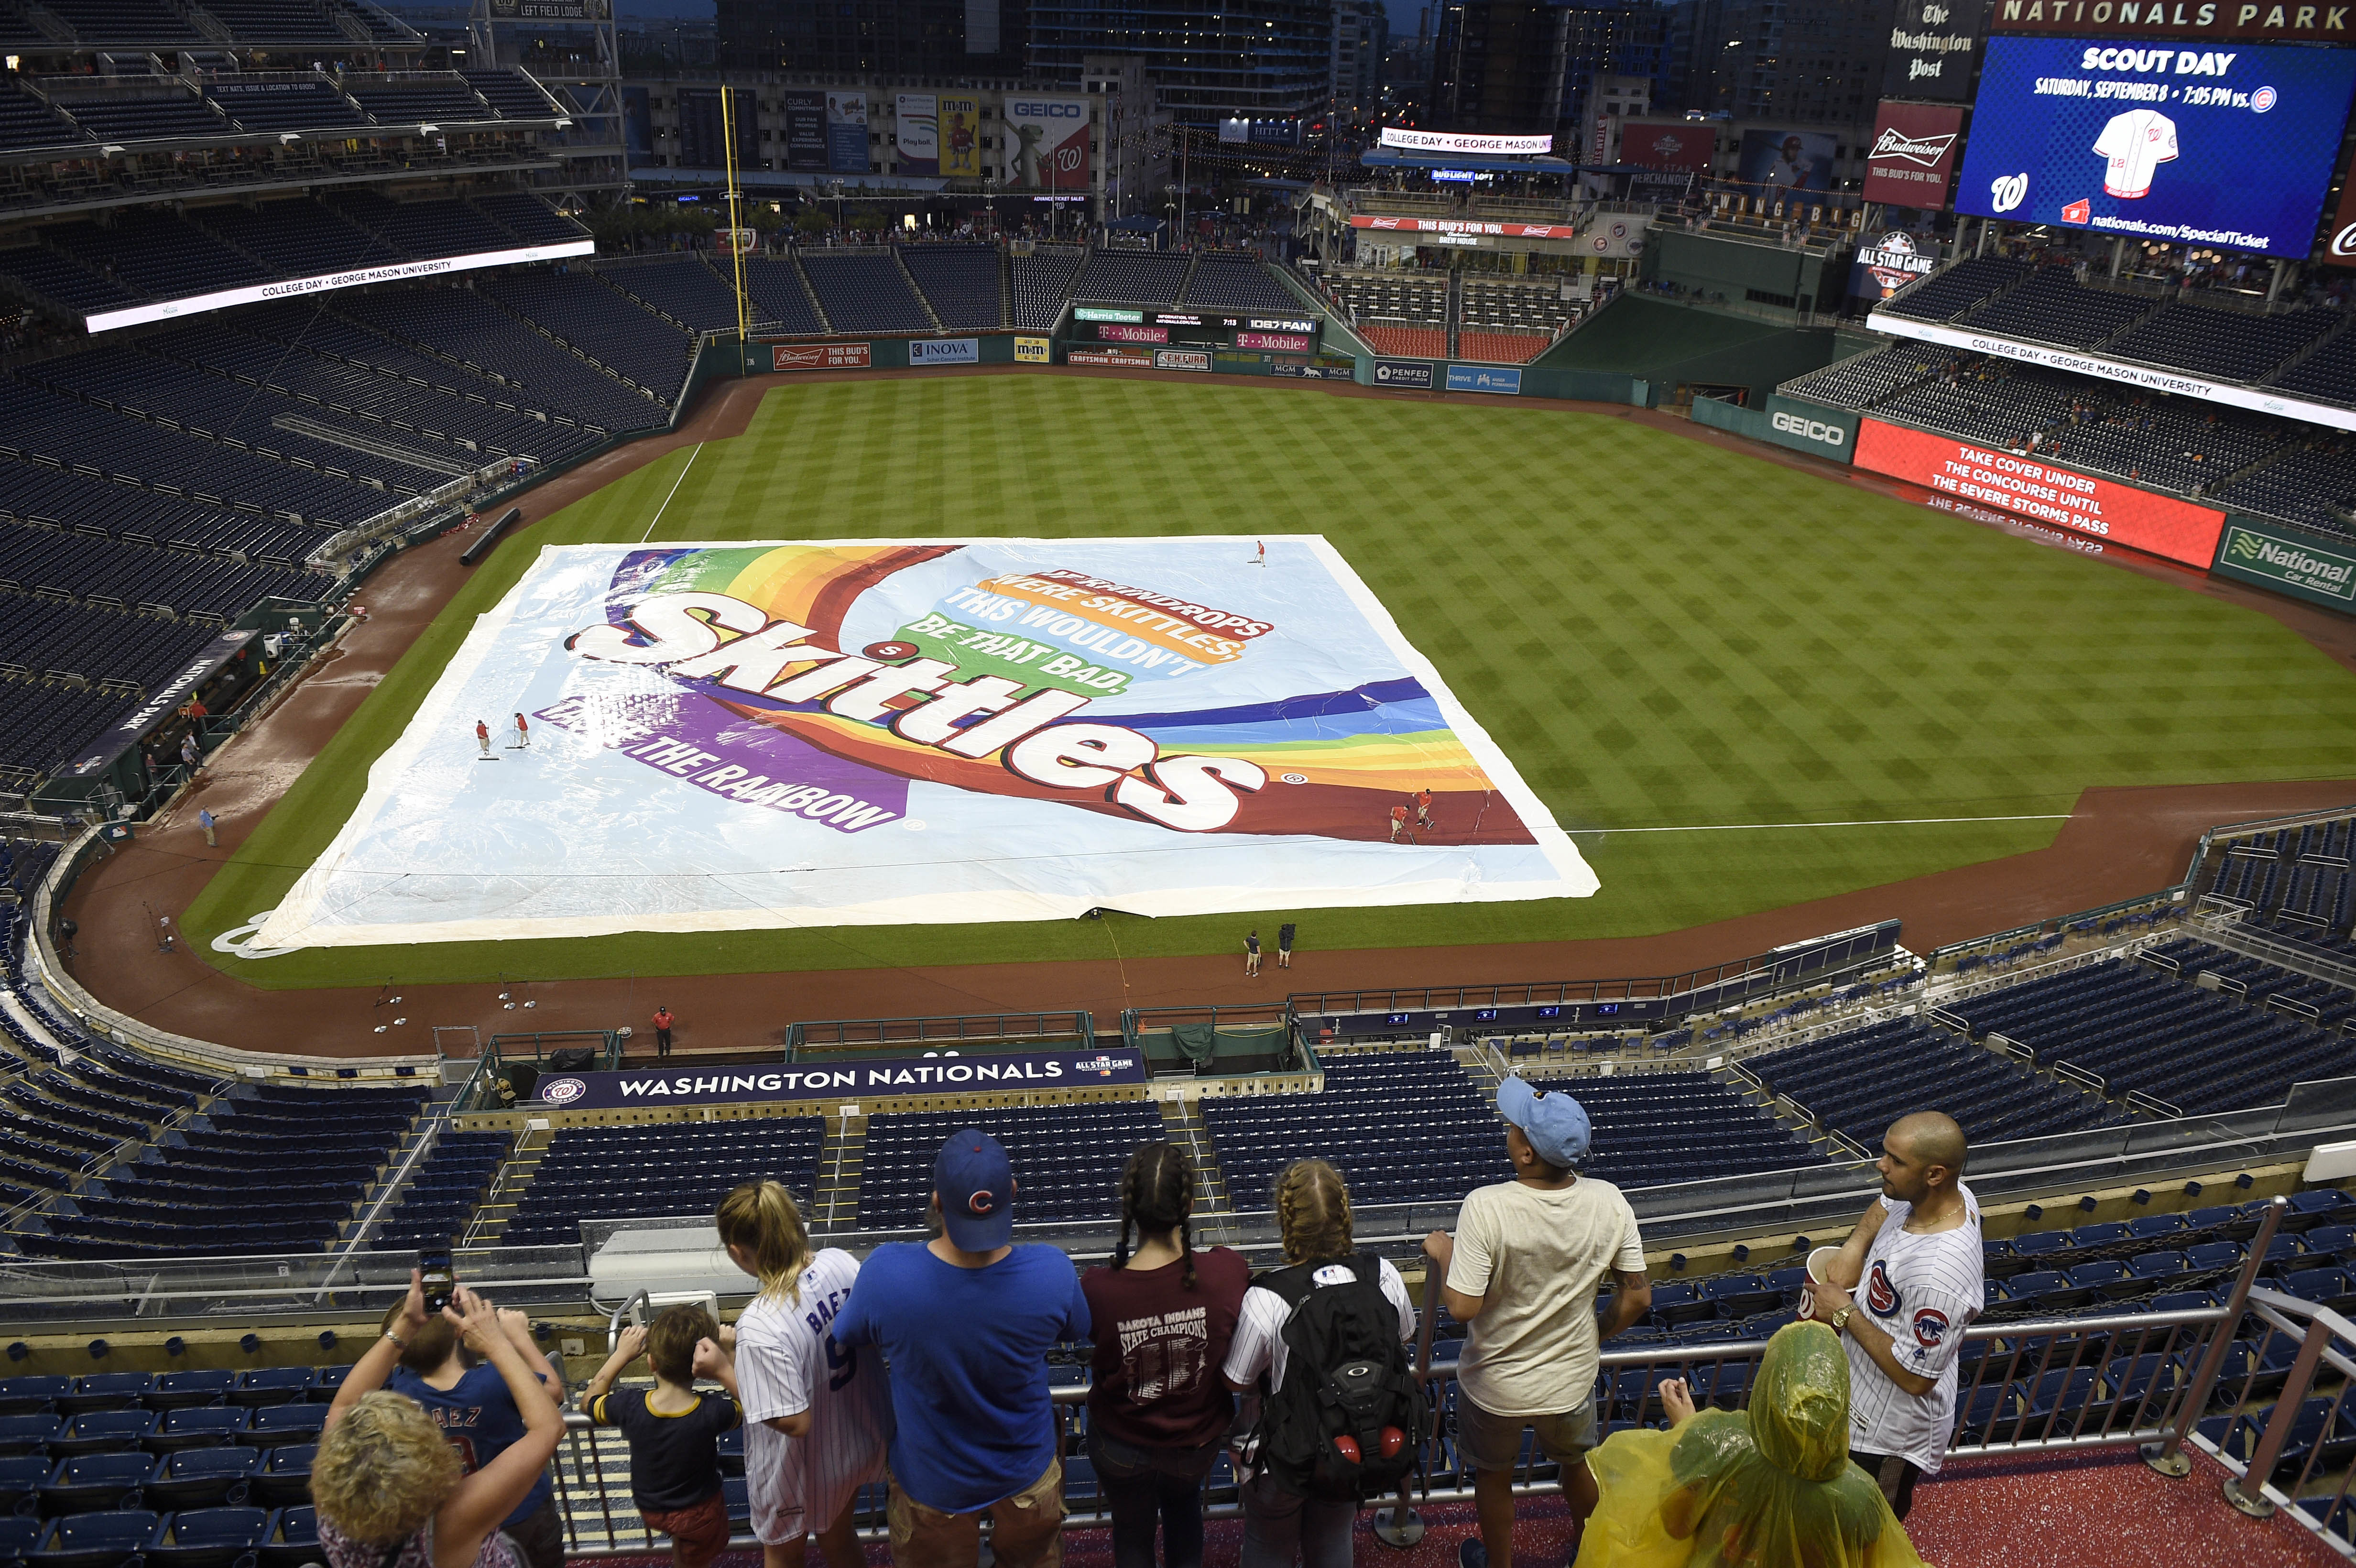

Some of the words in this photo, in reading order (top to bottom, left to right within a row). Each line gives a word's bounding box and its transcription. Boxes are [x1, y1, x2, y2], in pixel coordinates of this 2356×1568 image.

[521, 5, 538, 16] LEFT
[540, 5, 559, 17] FIELD
[561, 6, 583, 17] LODGE
[1922, 4, 1950, 26] The
[2002, 1, 2217, 26] NATIONALS
[2237, 4, 2349, 30] PARK
[1890, 27, 1973, 55] Washington
[1909, 58, 1943, 81] Post
[2081, 47, 2174, 73] SCOUT
[2175, 52, 2237, 76] DAY
[2034, 77, 2092, 100] SATURDAY,
[2094, 81, 2160, 101] SEPTEMBER
[2158, 85, 2169, 102] 8
[2182, 86, 2212, 105] 7:05
[2211, 87, 2233, 106] PM
[2233, 93, 2250, 108] vs.
[1014, 102, 1080, 118] GEICO
[1254, 127, 1281, 135] HITT
[1386, 132, 1418, 144] COLLEGE
[1421, 136, 1442, 146] DAY
[1454, 139, 1502, 149] GEORGE
[1505, 141, 1537, 149] MASON
[1596, 130, 1605, 149] TEAM
[1878, 135, 1944, 155] Budweiser
[2111, 157, 2126, 168] 18
[1450, 171, 1473, 179] LIGHT
[1632, 174, 1695, 186] MERCHANDISE
[1872, 167, 1887, 177] THIS
[1888, 169, 1909, 180] BUD'S
[1910, 171, 1926, 181] FOR
[1926, 174, 1942, 183] YOU.
[1418, 220, 1437, 230] THIS
[1438, 221, 1464, 231] BUD'S
[1465, 223, 1483, 232] FOR
[1484, 224, 1503, 234] YOU.
[2092, 215, 2270, 249] nationals.com/SpecialTicket
[1439, 237, 1456, 245] BREW
[1856, 248, 1876, 264] ALL
[1876, 251, 1904, 269] STAR
[1903, 256, 1933, 274] GAME
[262, 283, 304, 296] COLLEGE
[306, 280, 322, 291] DAY
[332, 275, 366, 285] GEORGE
[369, 269, 400, 280] MASON
[403, 261, 451, 274] UNIVERSITY
[1087, 312, 1113, 320] Harris
[1114, 313, 1140, 321] Teeter
[1282, 321, 1311, 331] FAN
[780, 352, 819, 361] Budweiser
[828, 348, 844, 356] THIS
[846, 347, 868, 355] BUD'S
[828, 357, 843, 365] FOR
[844, 356, 861, 364] YOU.
[927, 344, 967, 355] INOVA
[1070, 355, 1108, 363] CRAFTSMAN
[1112, 357, 1150, 366] CRAFTSMAN
[1393, 369, 1429, 378] PENFED
[1449, 374, 1472, 382] THRIVE
[1972, 339, 2017, 356] COLLEGE
[2020, 348, 2040, 360] DAY
[2050, 355, 2094, 372] GEORGE
[2097, 365, 2138, 381] MASON
[2140, 373, 2211, 396] UNIVERSITY
[1772, 412, 1844, 446] GEICO
[1959, 447, 1995, 467] TAKE
[1996, 457, 2043, 480] COVER
[2045, 470, 2096, 495] UNDER
[1945, 460, 1971, 478] THE
[1972, 468, 2058, 502] CONCOURSE
[2059, 491, 2103, 515] UNTIL
[1932, 474, 1958, 491] THE
[1959, 482, 2011, 507] SEVERE
[2012, 497, 2069, 523] STORMS
[2071, 514, 2110, 535] PASS
[2257, 542, 2353, 583] National
[2285, 570, 2304, 581] Car
[2304, 577, 2343, 593] Rental
[1040, 571, 1087, 580] IF
[1077, 577, 1272, 637] RAINDROPS
[994, 573, 1090, 602] WERE
[1081, 596, 1245, 661] SKITTLES,
[950, 586, 1025, 621] THIS
[1019, 605, 1204, 676] WOULDN'T
[878, 645, 903, 656] S
[908, 615, 969, 639] BE
[957, 627, 1052, 664] THAT
[1039, 654, 1128, 694] BAD.
[150, 659, 216, 705] NATIONALS
[119, 707, 162, 730] PARK
[569, 593, 1269, 831] Skittles
[630, 736, 719, 774] THE
[698, 764, 898, 831] RAINBOW
[547, 1080, 582, 1090] WASHINGTON
[619, 1070, 856, 1097] WASHINGTON
[869, 1060, 1063, 1086] NATIONALS
[555, 1085, 573, 1097] W
[969, 1190, 992, 1213] C
[1117, 1315, 1162, 1332] DAKOTA
[1164, 1307, 1206, 1325] INDIANS
[1120, 1329, 1149, 1357] STATE
[1150, 1319, 1208, 1340] CHAMPIONS
[825, 1334, 857, 1392] 9
